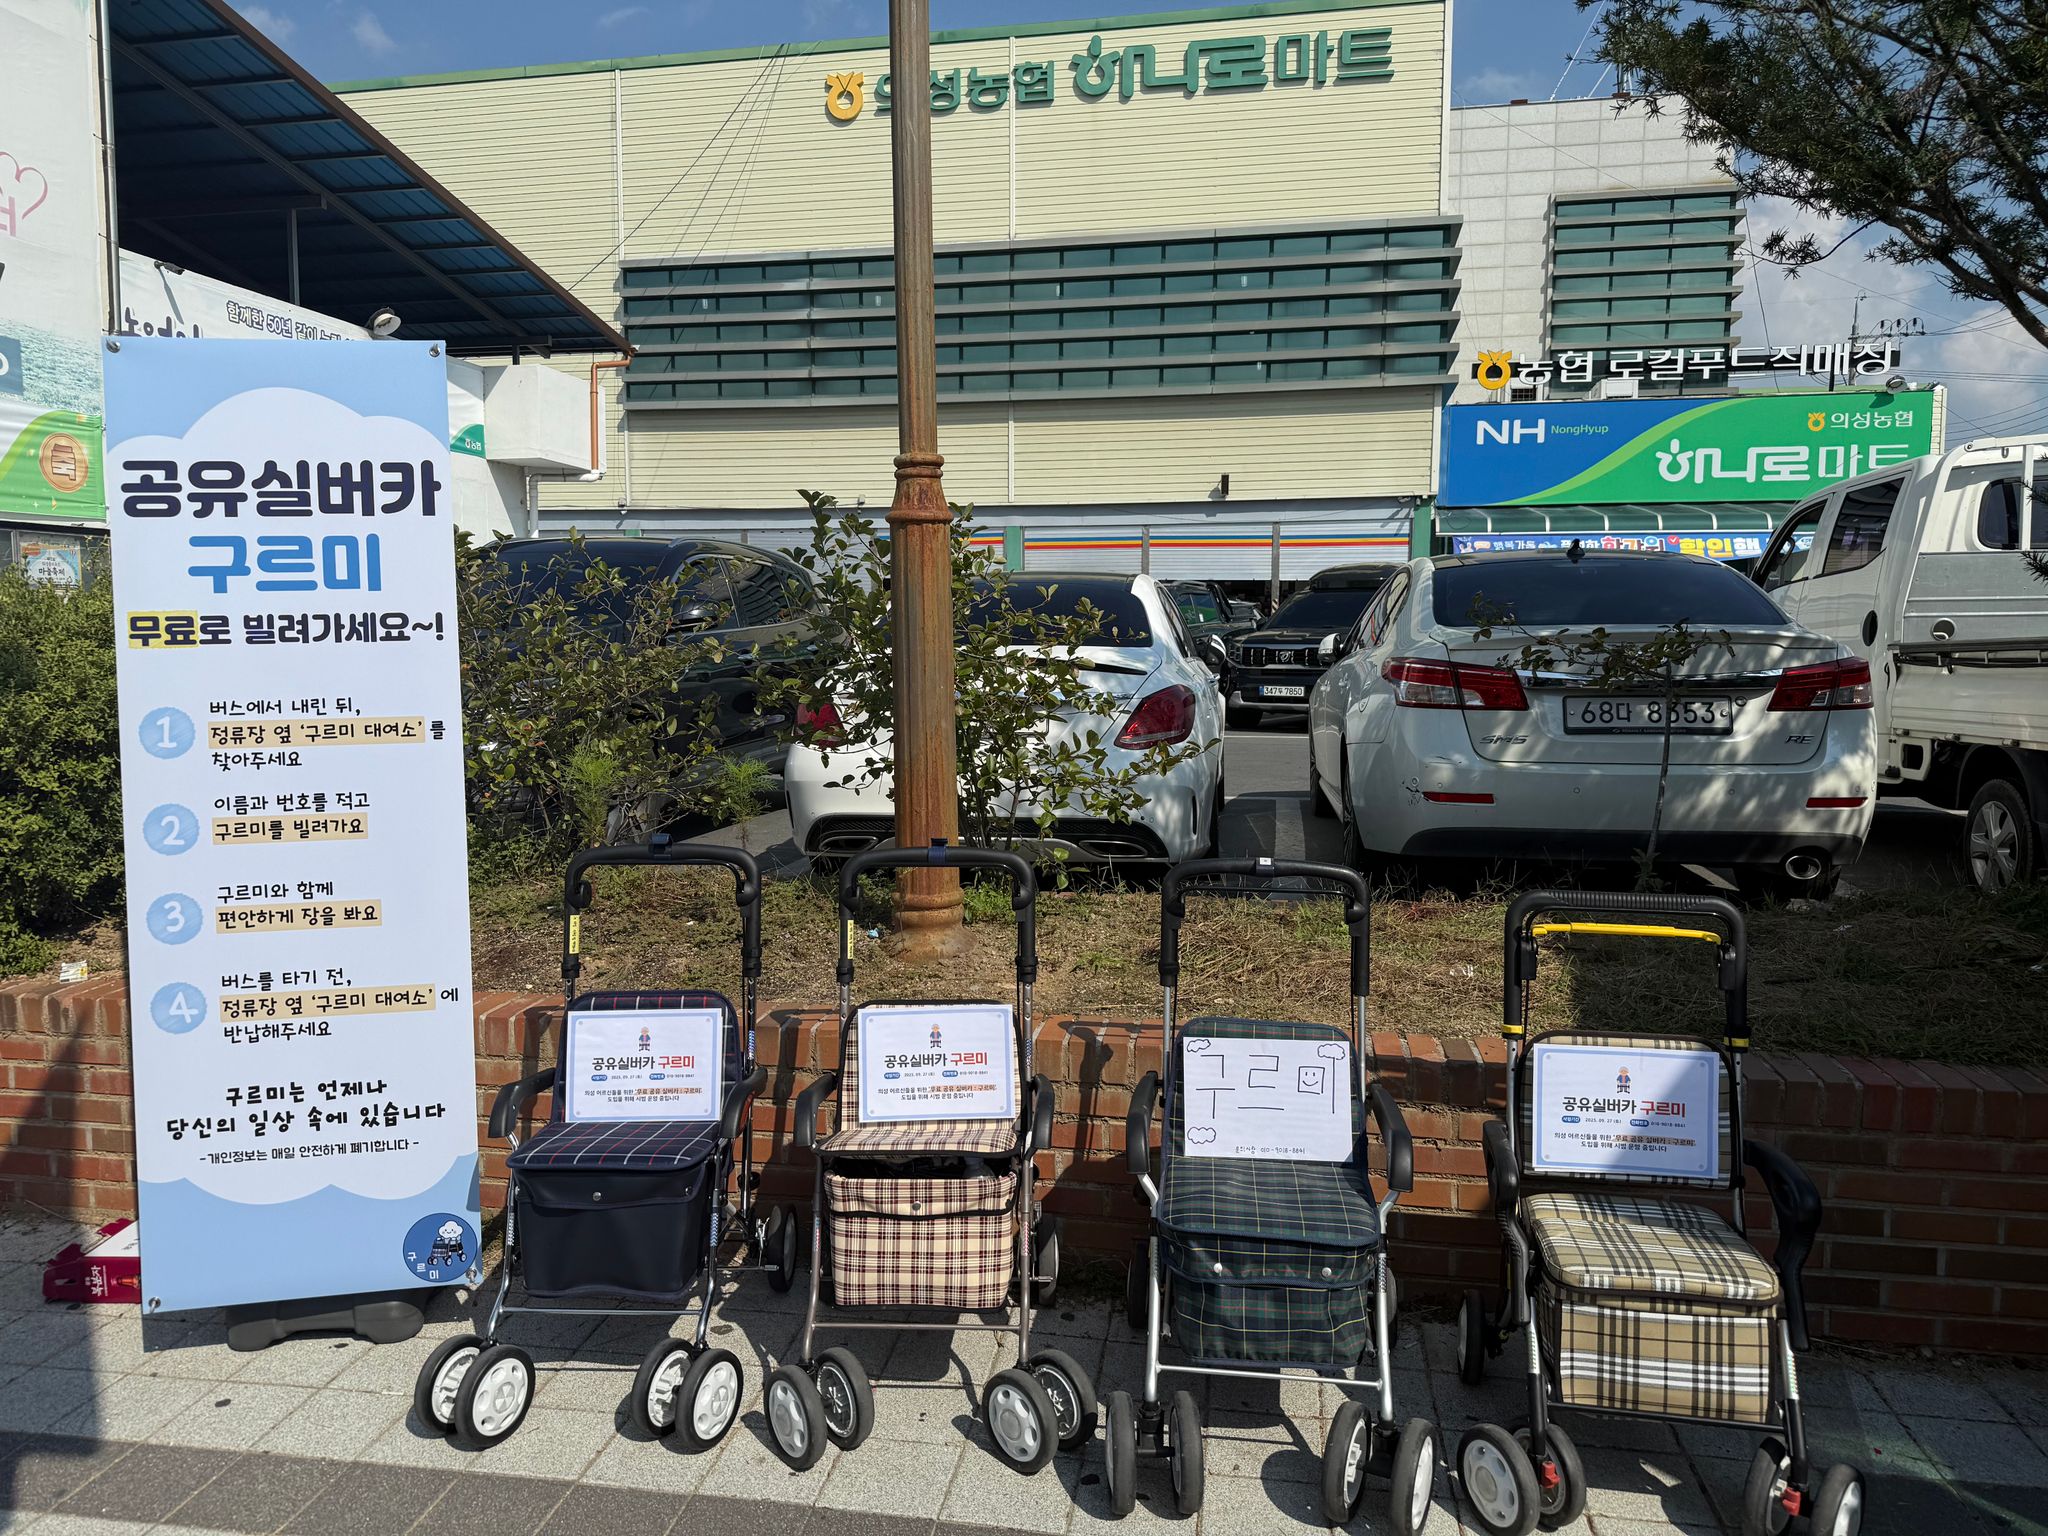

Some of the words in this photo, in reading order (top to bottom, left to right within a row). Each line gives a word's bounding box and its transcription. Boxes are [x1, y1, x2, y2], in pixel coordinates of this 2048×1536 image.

[1073, 28, 1394, 97] 하나로마트
[227, 300, 264, 330] 함께한
[267, 314, 292, 338] 50년
[296, 322, 317, 340] 같이
[1518, 351, 1592, 385] 농협
[1610, 343, 1892, 382] 로컬푸드직매장
[1477, 419, 1545, 444] NH
[1551, 423, 1608, 436] NongHyup
[1830, 411, 1912, 429] 의성농협
[1655, 439, 1909, 484] 하나로마트
[120, 459, 441, 518] 공유실버카
[188, 533, 382, 593] 구르미
[129, 614, 231, 646] 무료로
[244, 612, 444, 645] 빌려가세요~!
[210, 697, 282, 716] 버스에서
[292, 697, 328, 715] 내린
[336, 697, 361, 717] 뒤,
[1582, 702, 1632, 723] 68다
[158, 717, 176, 748] 1
[210, 724, 263, 745] 정류장
[274, 723, 293, 744] 옆
[430, 721, 446, 741] 를
[1785, 735, 1814, 744] RE
[213, 750, 302, 772] 찾아주세요
[214, 794, 269, 815] 이름과
[277, 794, 328, 812] 번호를
[337, 793, 370, 810] 적고
[161, 815, 186, 845] 2
[215, 820, 285, 842] 구르미를
[293, 818, 365, 838] 빌려가요
[218, 883, 288, 904] 구르미와
[297, 881, 334, 900] 함께
[166, 901, 185, 932] 3
[218, 907, 294, 929] 편안하게
[302, 906, 336, 927] 장을
[344, 904, 379, 924] 봐요
[221, 971, 274, 992] 버스를
[281, 968, 318, 987] 타기
[326, 967, 352, 987] 전,
[169, 992, 198, 1024] 4
[222, 996, 276, 1018] 정류장
[285, 995, 304, 1016] 옆
[441, 988, 459, 1003] 에
[223, 1021, 332, 1044] 반납해주세요
[592, 1057, 655, 1071] 공유실버카
[658, 1056, 694, 1069] 구르미
[884, 1054, 947, 1068] 공유실버카
[950, 1052, 987, 1066] 구르미
[225, 1083, 305, 1106] 구르미는
[318, 1080, 387, 1099] 언제나
[1562, 1097, 1636, 1113] 공유실버카
[1640, 1101, 1686, 1118] 구르미
[166, 1116, 236, 1140] 당신의
[249, 1110, 295, 1136] 일상
[308, 1106, 348, 1130] 속에
[360, 1103, 446, 1128] 있습니다
[271, 1146, 295, 1161] 매일
[299, 1143, 348, 1159] 안전하게
[408, 1252, 439, 1279] 구르미
